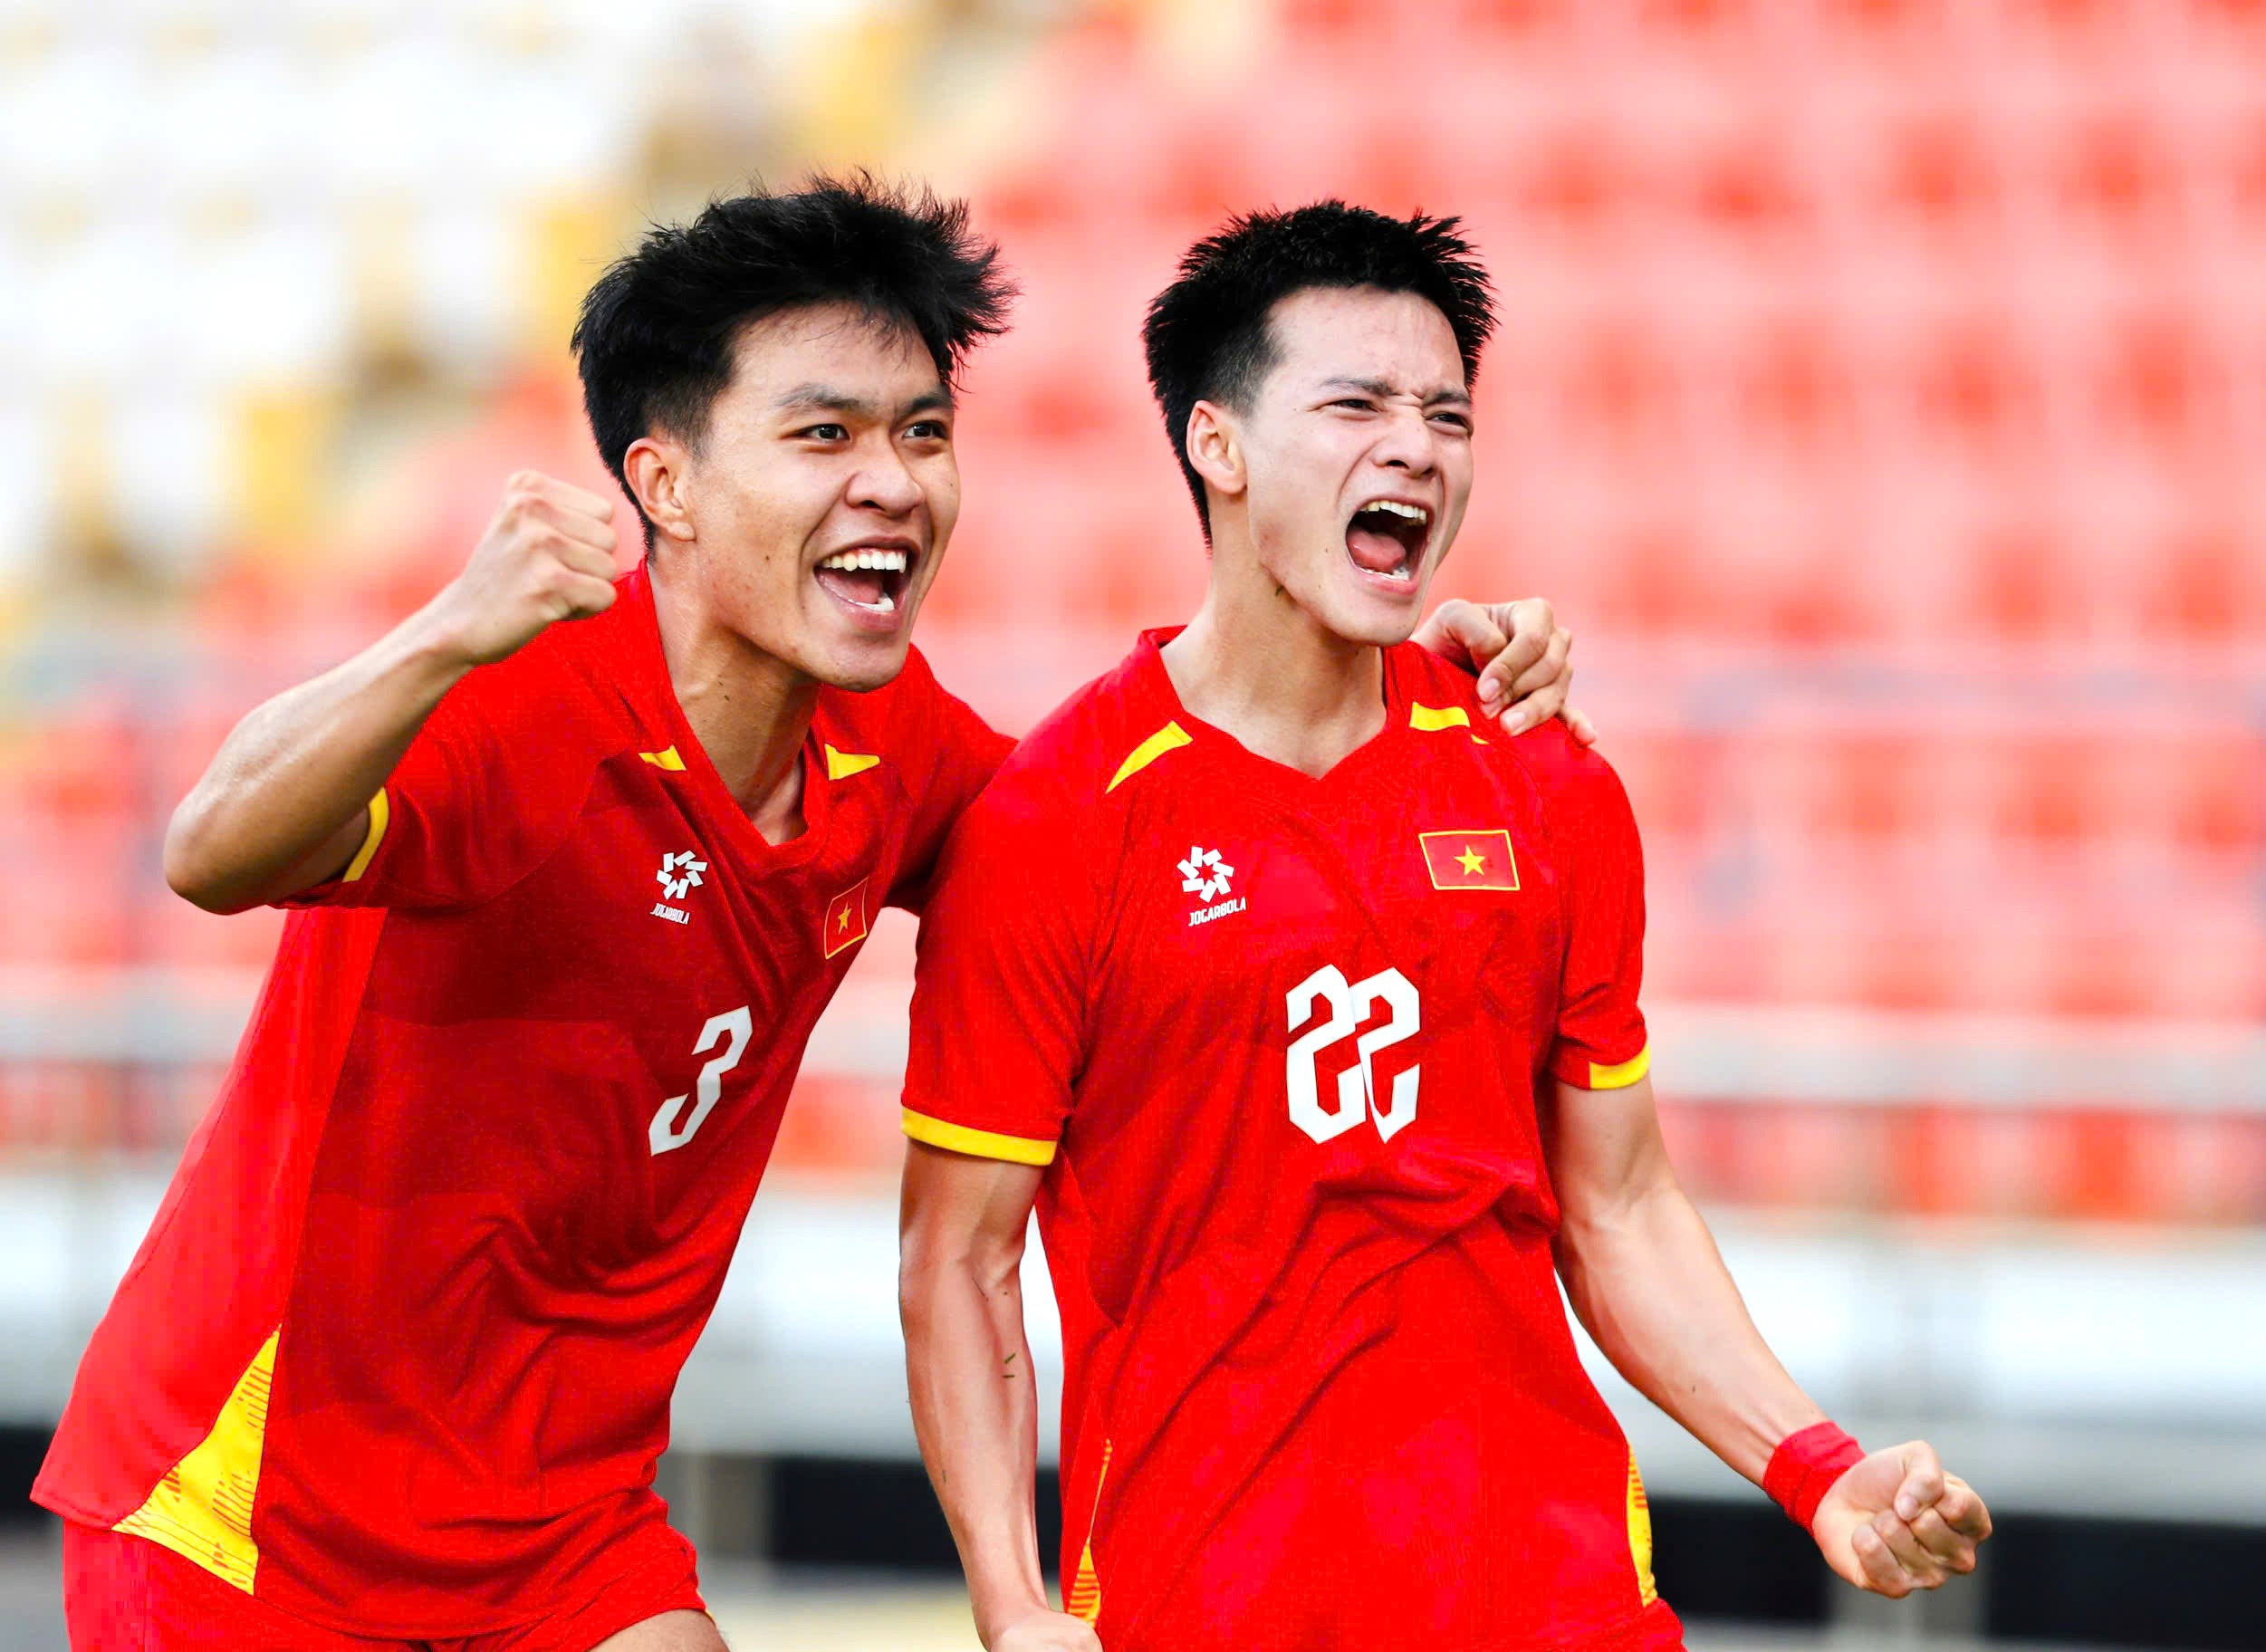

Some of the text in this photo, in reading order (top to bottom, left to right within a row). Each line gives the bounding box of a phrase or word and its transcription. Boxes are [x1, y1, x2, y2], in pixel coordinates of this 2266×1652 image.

[1188, 897, 1246, 927] JOGARBOLA
[648, 1005, 753, 1157] 3
[1286, 964, 1420, 1144] 22
